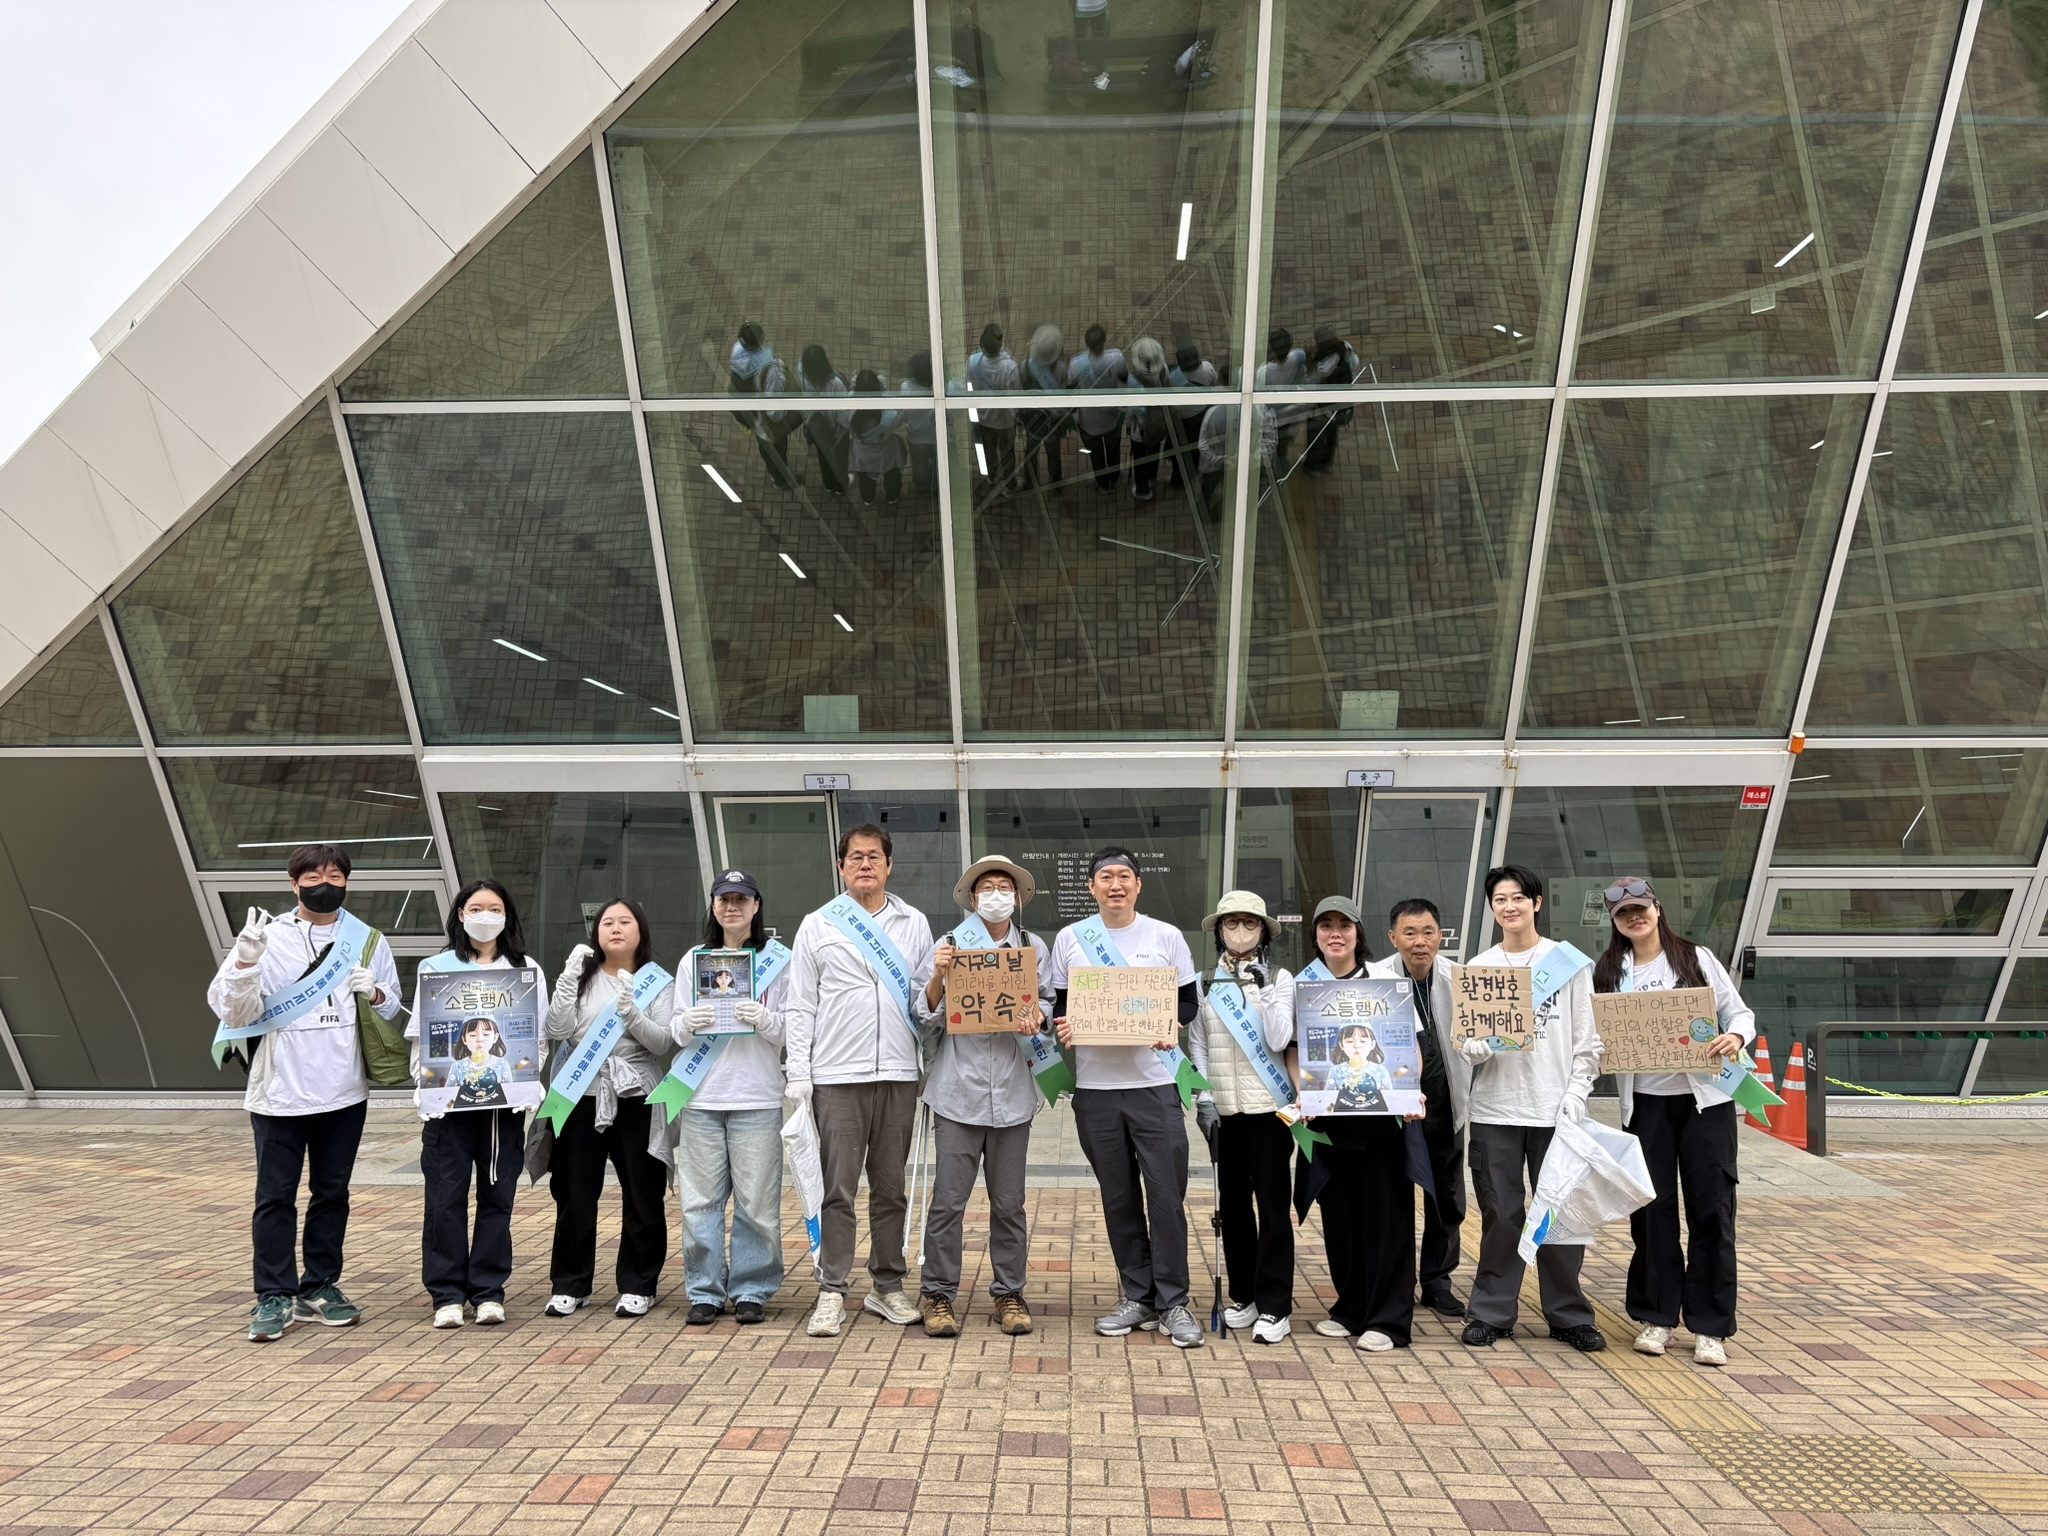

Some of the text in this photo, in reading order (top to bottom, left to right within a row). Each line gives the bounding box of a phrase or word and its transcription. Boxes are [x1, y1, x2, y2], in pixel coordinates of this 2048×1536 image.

[952, 951, 1023, 972] 지구의 날
[460, 982, 482, 992] 전국
[955, 973, 1026, 992] 미래를 위한
[1074, 972, 1110, 992] 지구를
[1116, 973, 1138, 991] 위한
[1459, 972, 1520, 1002] 환경보호
[444, 992, 514, 1010] 소등행사
[1072, 995, 1120, 1014] 지금부터
[1335, 990, 1357, 1000] 전국
[1650, 995, 1703, 1014] 아프면
[320, 1014, 340, 1023] FIFA
[1321, 1001, 1390, 1018] 소등행사
[598, 1018, 617, 1040] 실천
[1070, 1016, 1092, 1032] 우리의
[1458, 1010, 1526, 1038] 함께해요
[1602, 1016, 1687, 1036] 우리의 생활은
[685, 1042, 711, 1076] 캠페인
[1606, 1049, 1646, 1068] 지구를
